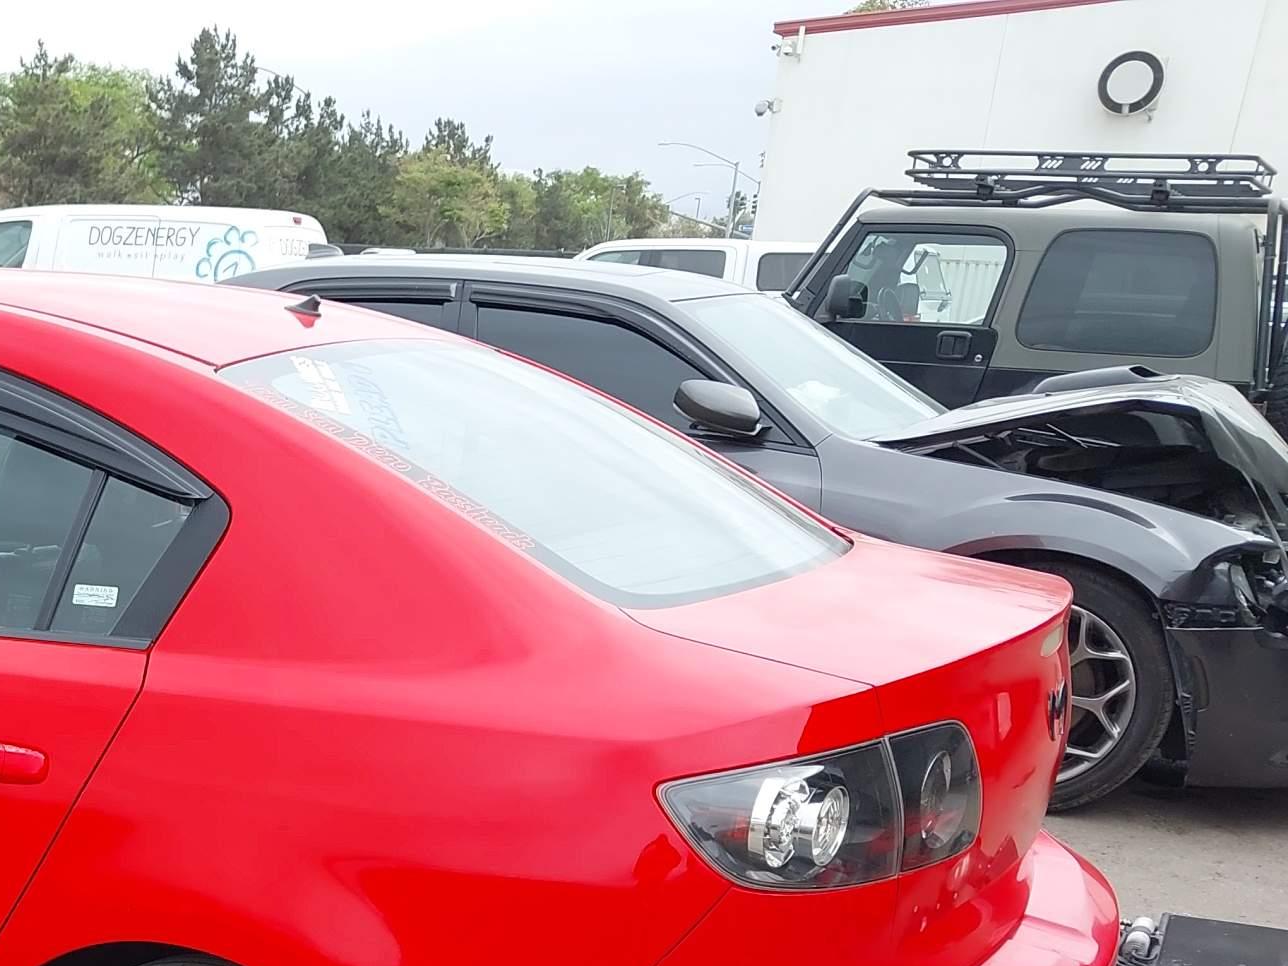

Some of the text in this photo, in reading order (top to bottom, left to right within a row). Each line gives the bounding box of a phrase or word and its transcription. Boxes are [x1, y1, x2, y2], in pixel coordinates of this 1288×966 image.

[88, 225, 201, 247] DOGZENERGY
[97, 249, 122, 259] walk
[159, 250, 185, 263] play
